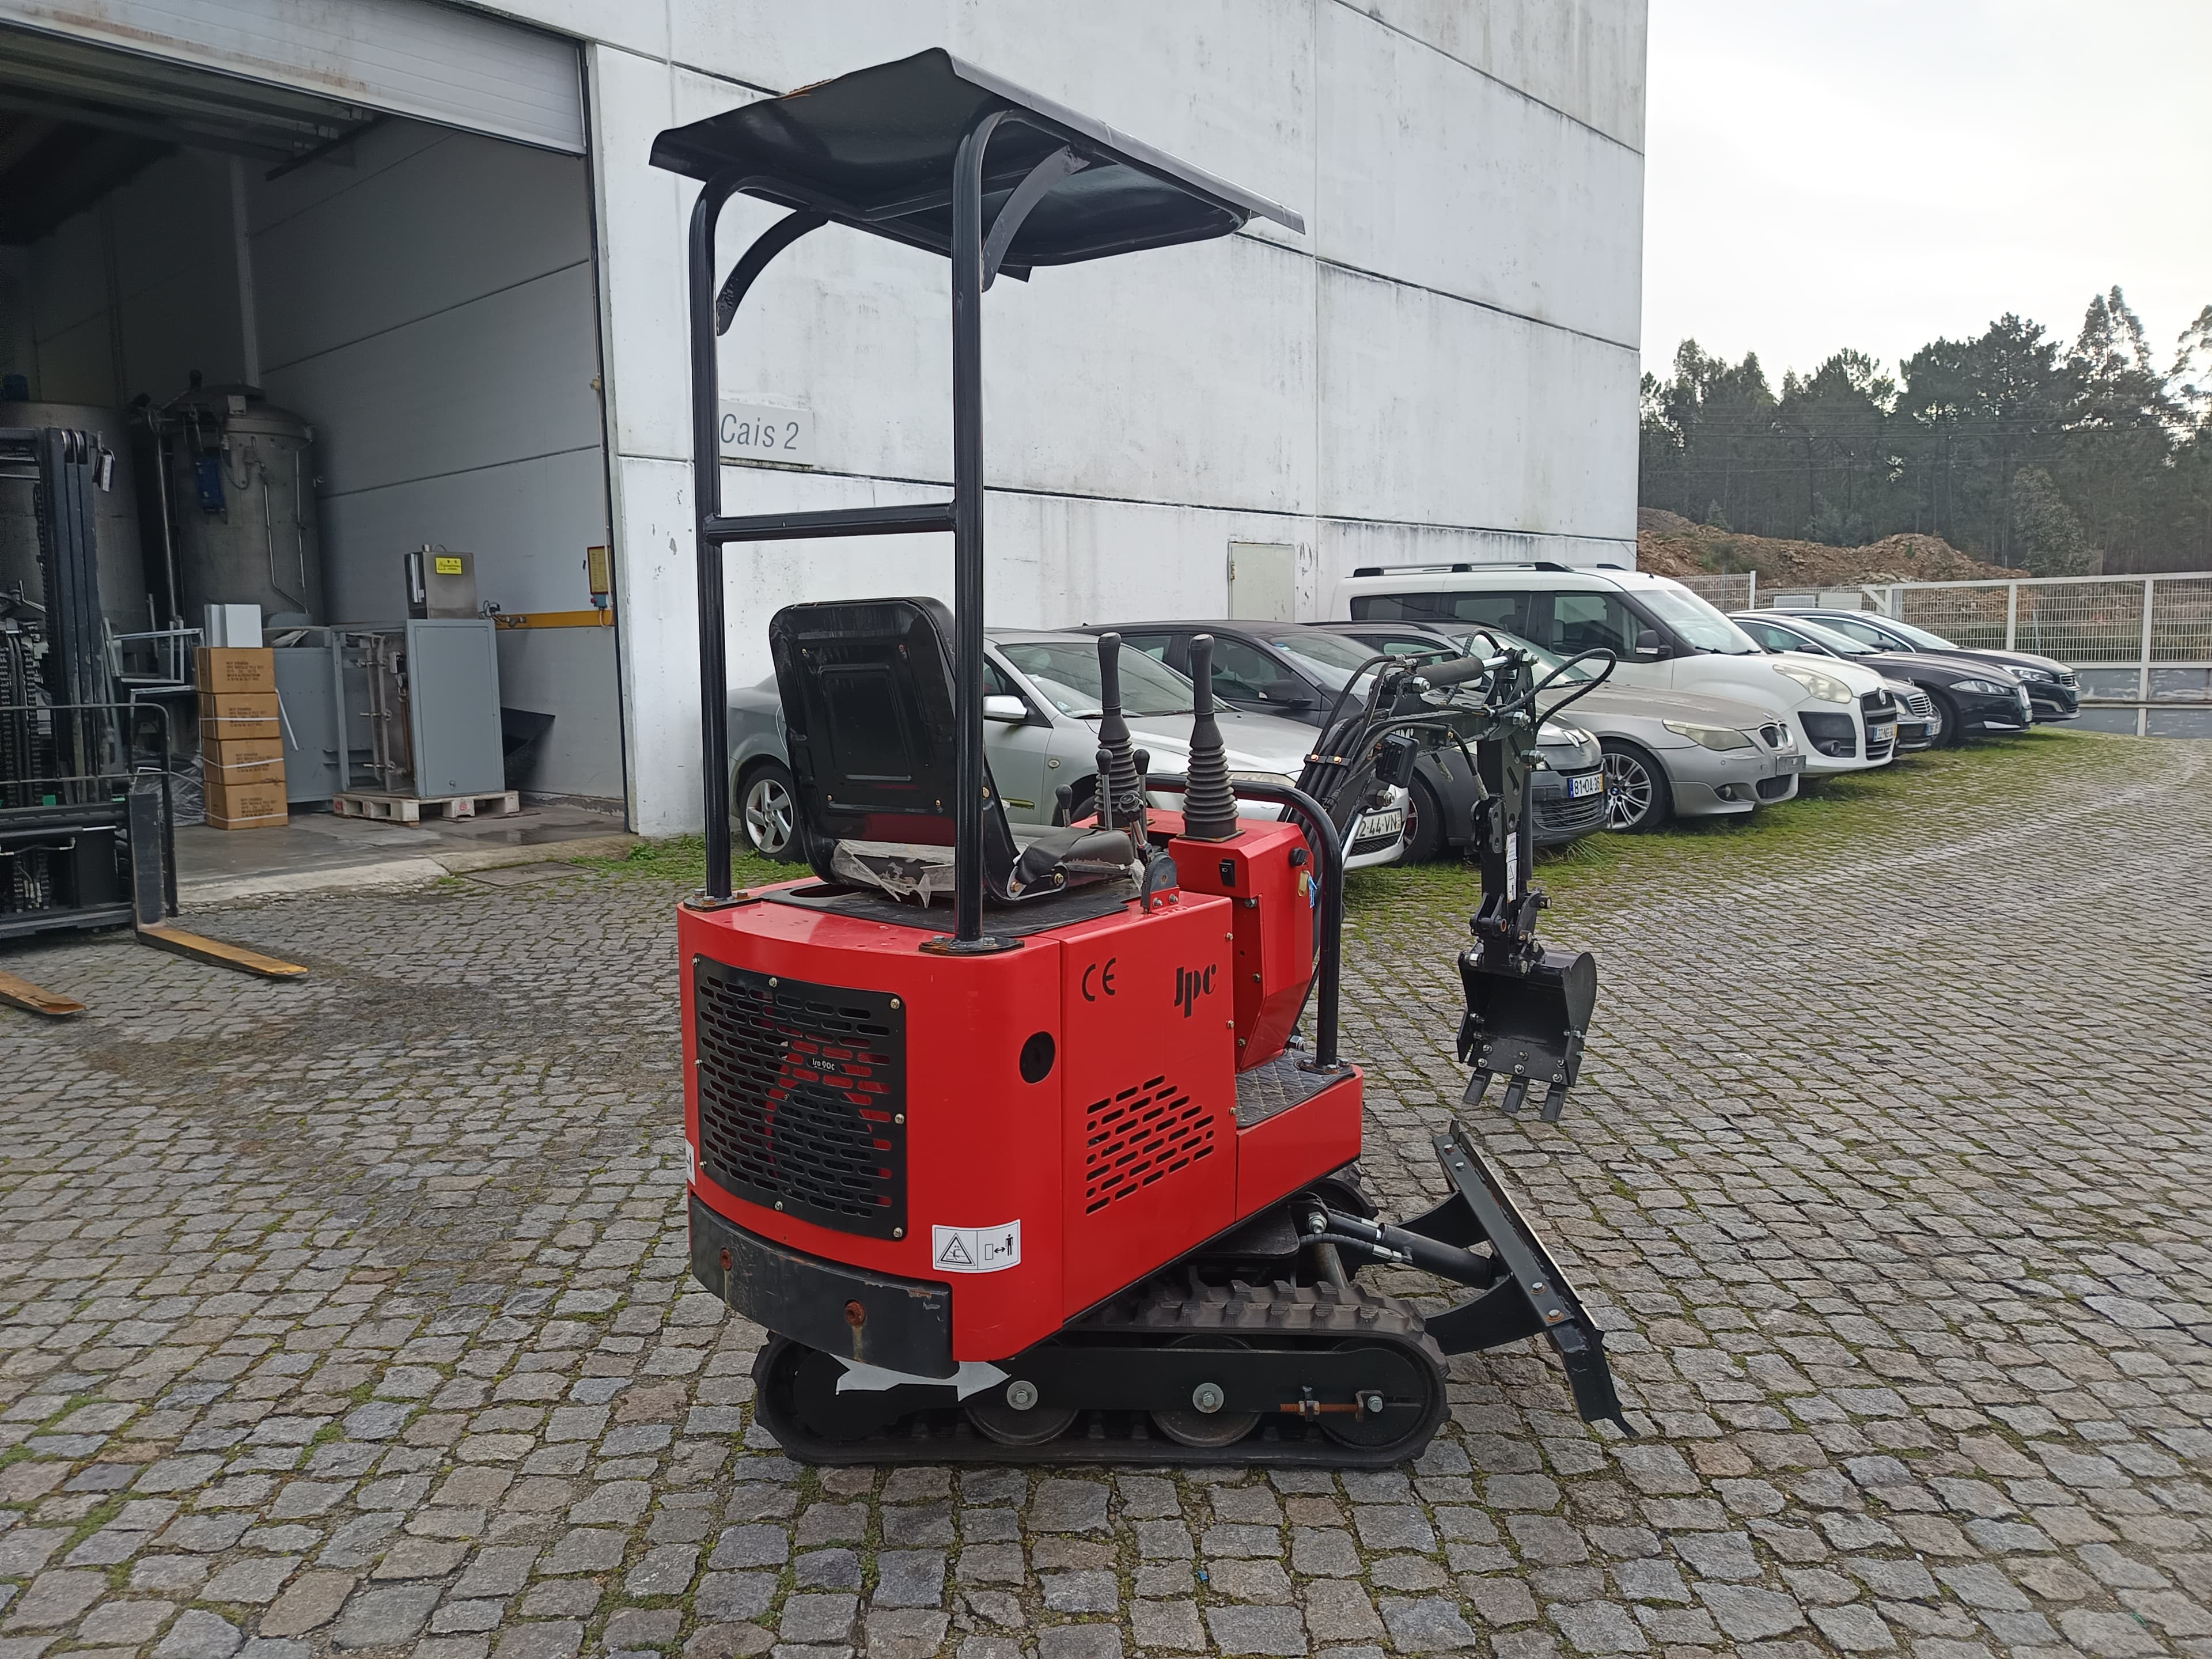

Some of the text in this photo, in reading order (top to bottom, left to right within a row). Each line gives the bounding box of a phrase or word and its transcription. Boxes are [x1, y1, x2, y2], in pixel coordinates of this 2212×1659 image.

[721, 414, 799, 450] Cais 2
[1359, 814, 1397, 837] 2-44-VN
[1082, 957, 1116, 1002] CE
